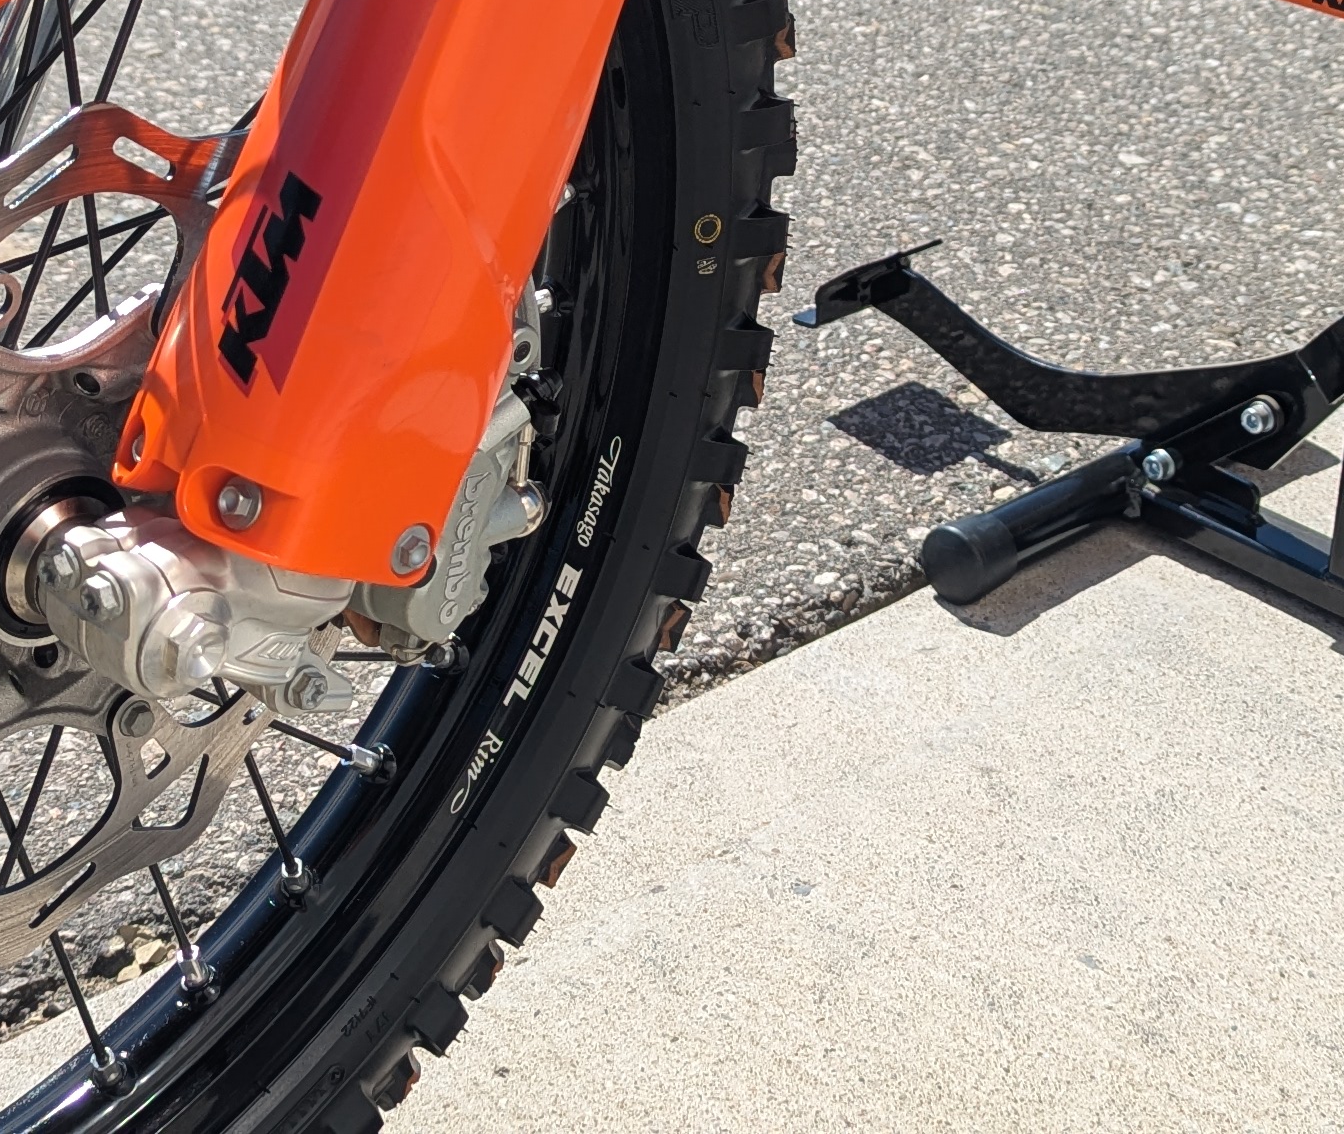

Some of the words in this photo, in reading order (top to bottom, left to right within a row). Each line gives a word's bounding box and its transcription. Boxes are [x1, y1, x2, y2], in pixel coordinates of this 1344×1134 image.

[218, 171, 323, 385] KTM
[439, 471, 491, 626] brembo
[577, 436, 621, 548] Takasago
[503, 562, 583, 707] EXCEL
[450, 728, 504, 814] Rim
